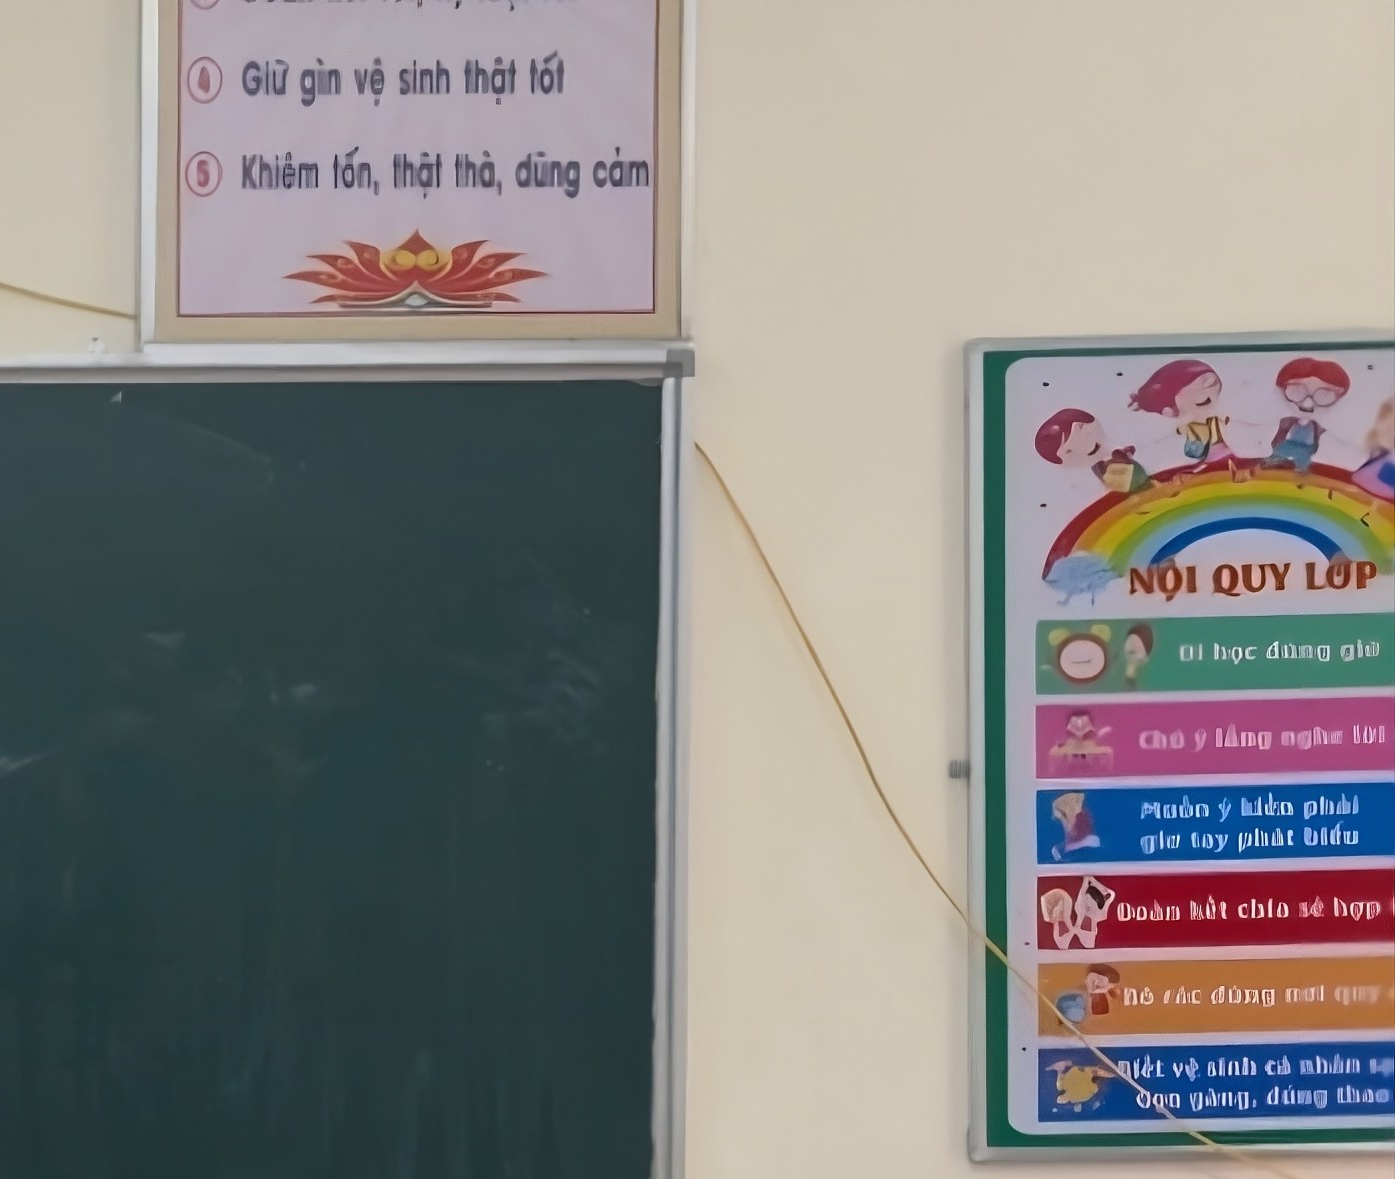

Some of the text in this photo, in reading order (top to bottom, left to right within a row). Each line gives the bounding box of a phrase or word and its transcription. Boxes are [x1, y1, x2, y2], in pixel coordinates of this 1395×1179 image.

[242, 59, 289, 96] Giữ
[300, 57, 341, 107] gìn
[354, 57, 384, 107] vệ
[399, 59, 450, 95] sinh
[465, 56, 516, 105] thật
[530, 50, 564, 94] tốt
[241, 151, 319, 189] Khiêm
[332, 146, 379, 195] tốn,
[393, 152, 442, 199] thật
[455, 151, 502, 195] thà,
[515, 151, 581, 198] dũng
[592, 146, 649, 188] cảm
[1212, 562, 1291, 597] QUY
